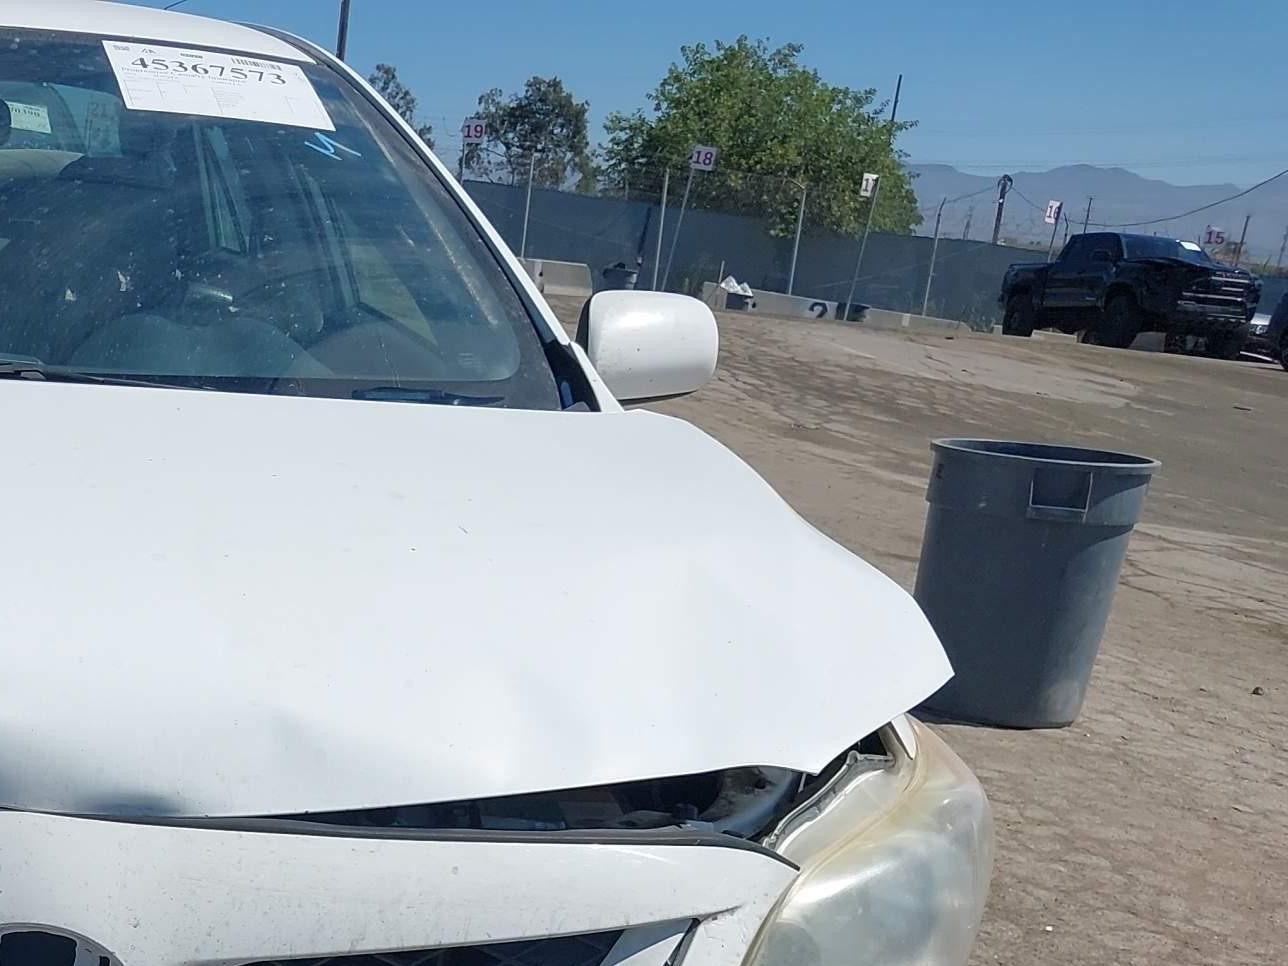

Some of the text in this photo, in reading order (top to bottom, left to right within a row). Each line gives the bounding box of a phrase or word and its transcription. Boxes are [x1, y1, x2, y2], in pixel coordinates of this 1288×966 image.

[131, 57, 287, 85] 45367573
[464, 124, 484, 139] 19
[692, 151, 713, 166] 18
[1204, 231, 1225, 245] 15
